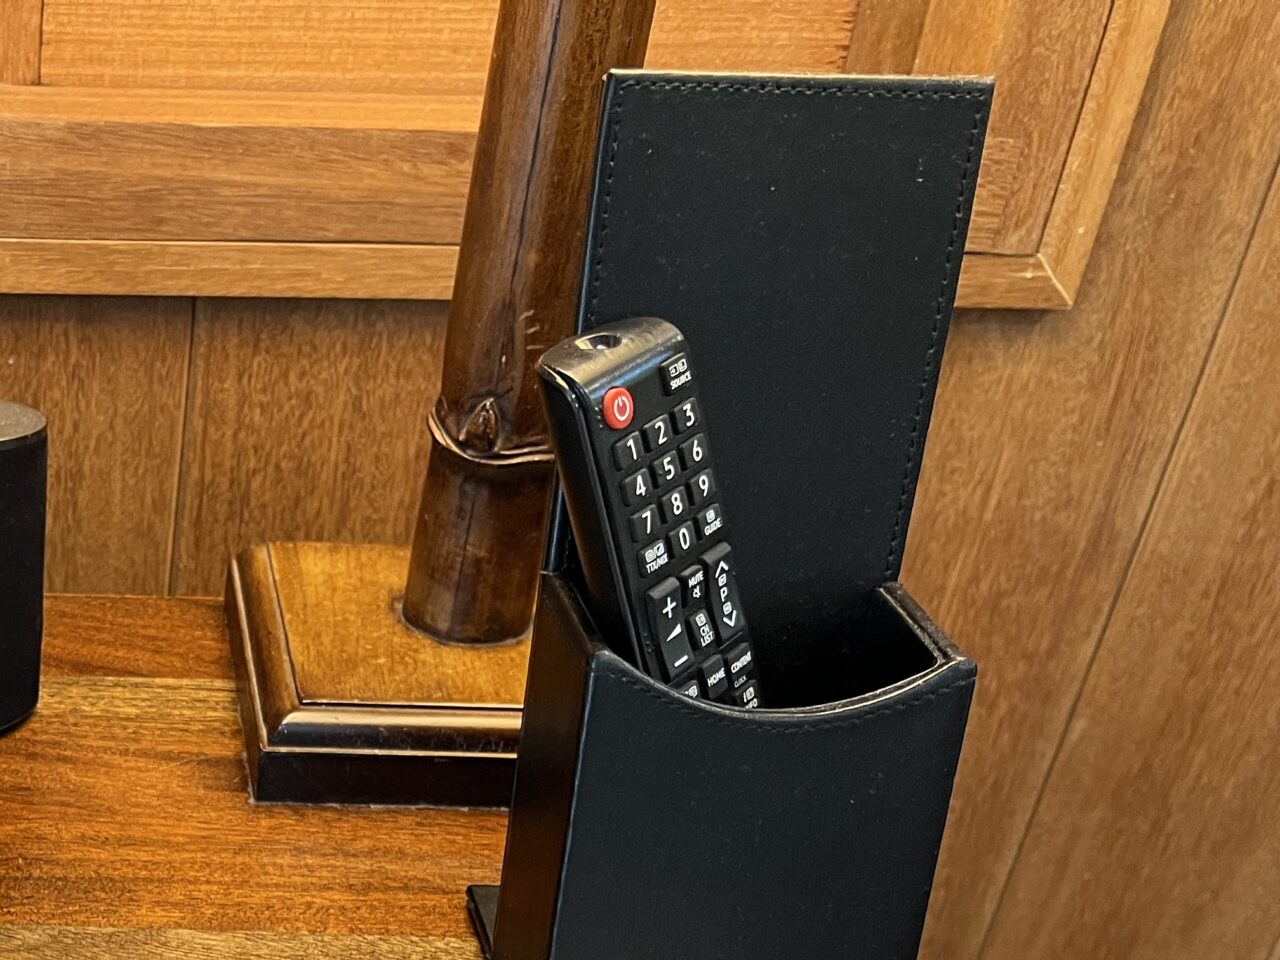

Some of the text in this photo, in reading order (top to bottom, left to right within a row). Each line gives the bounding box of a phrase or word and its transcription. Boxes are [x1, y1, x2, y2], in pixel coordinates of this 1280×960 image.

[670, 370, 692, 389] SOURCE
[627, 403, 695, 460] 1 2 3
[636, 440, 702, 496] 4 5 6
[642, 475, 709, 534] 7 8 9
[679, 528, 689, 549] 0
[689, 571, 704, 587] MUTE
[701, 632, 714, 647] LIST
[707, 667, 725, 687] HOME
